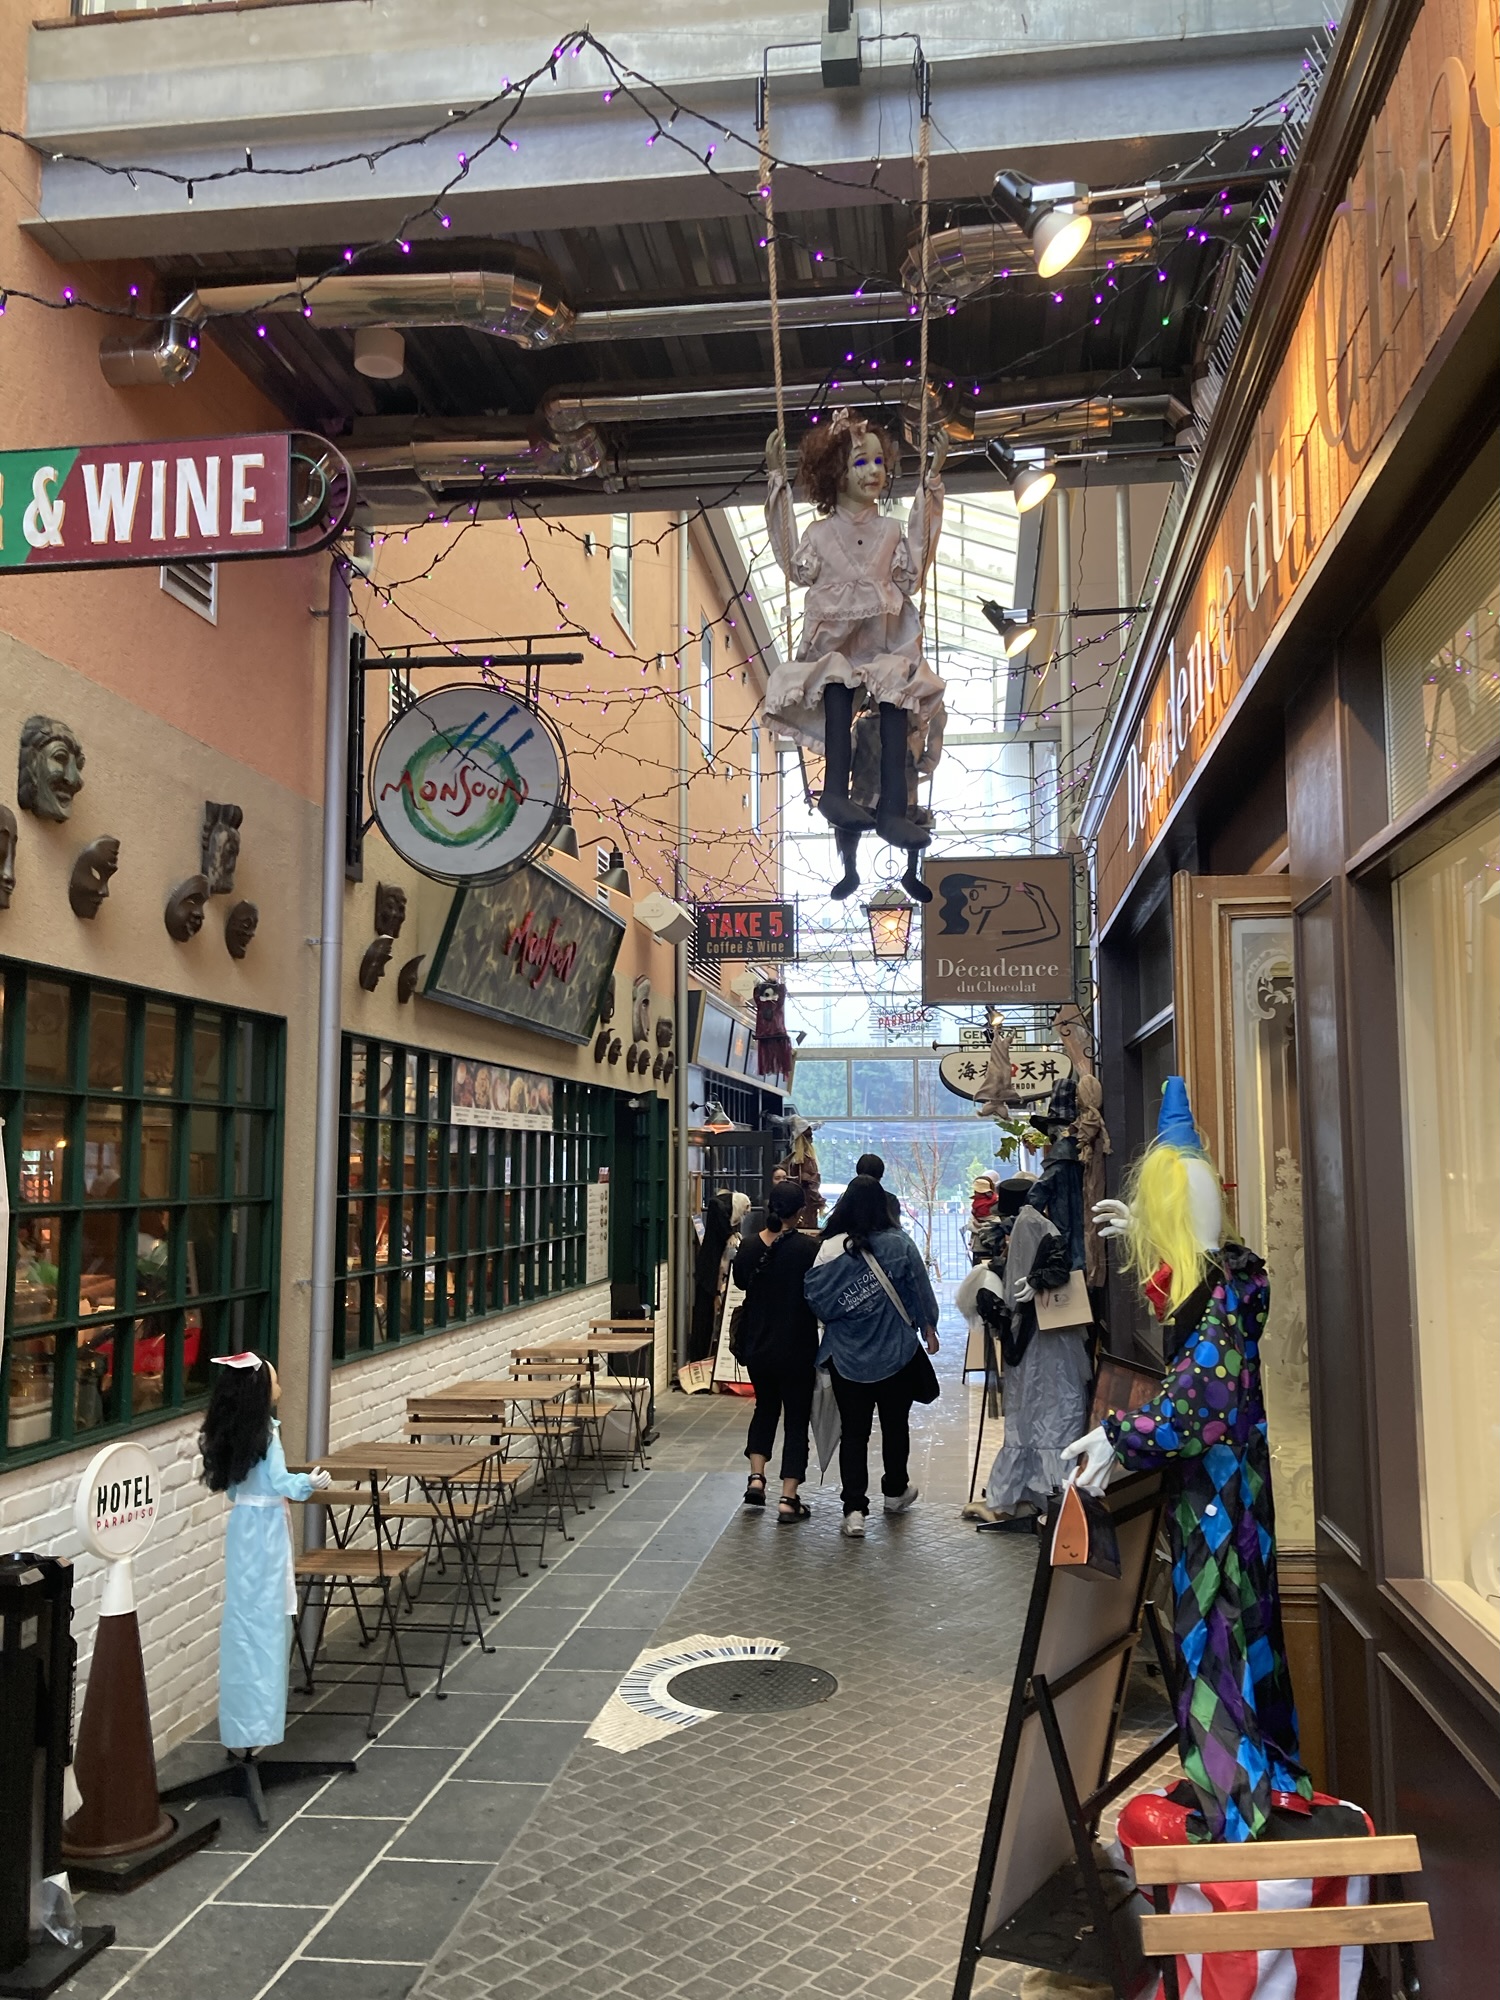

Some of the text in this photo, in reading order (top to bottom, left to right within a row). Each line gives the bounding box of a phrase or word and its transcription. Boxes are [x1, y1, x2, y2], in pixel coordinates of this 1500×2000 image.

[22, 466, 66, 548] &
[81, 453, 265, 545] WINE
[1244, 409, 1298, 613] du
[707, 911, 784, 938] TAKE 5
[706, 940, 785, 954] Coffee & Wine
[936, 957, 1059, 978] Décadence
[837, 1270, 893, 1306] CALIFORA
[96, 1475, 153, 1518] HOTEL
[96, 1506, 154, 1532] PARADISO
